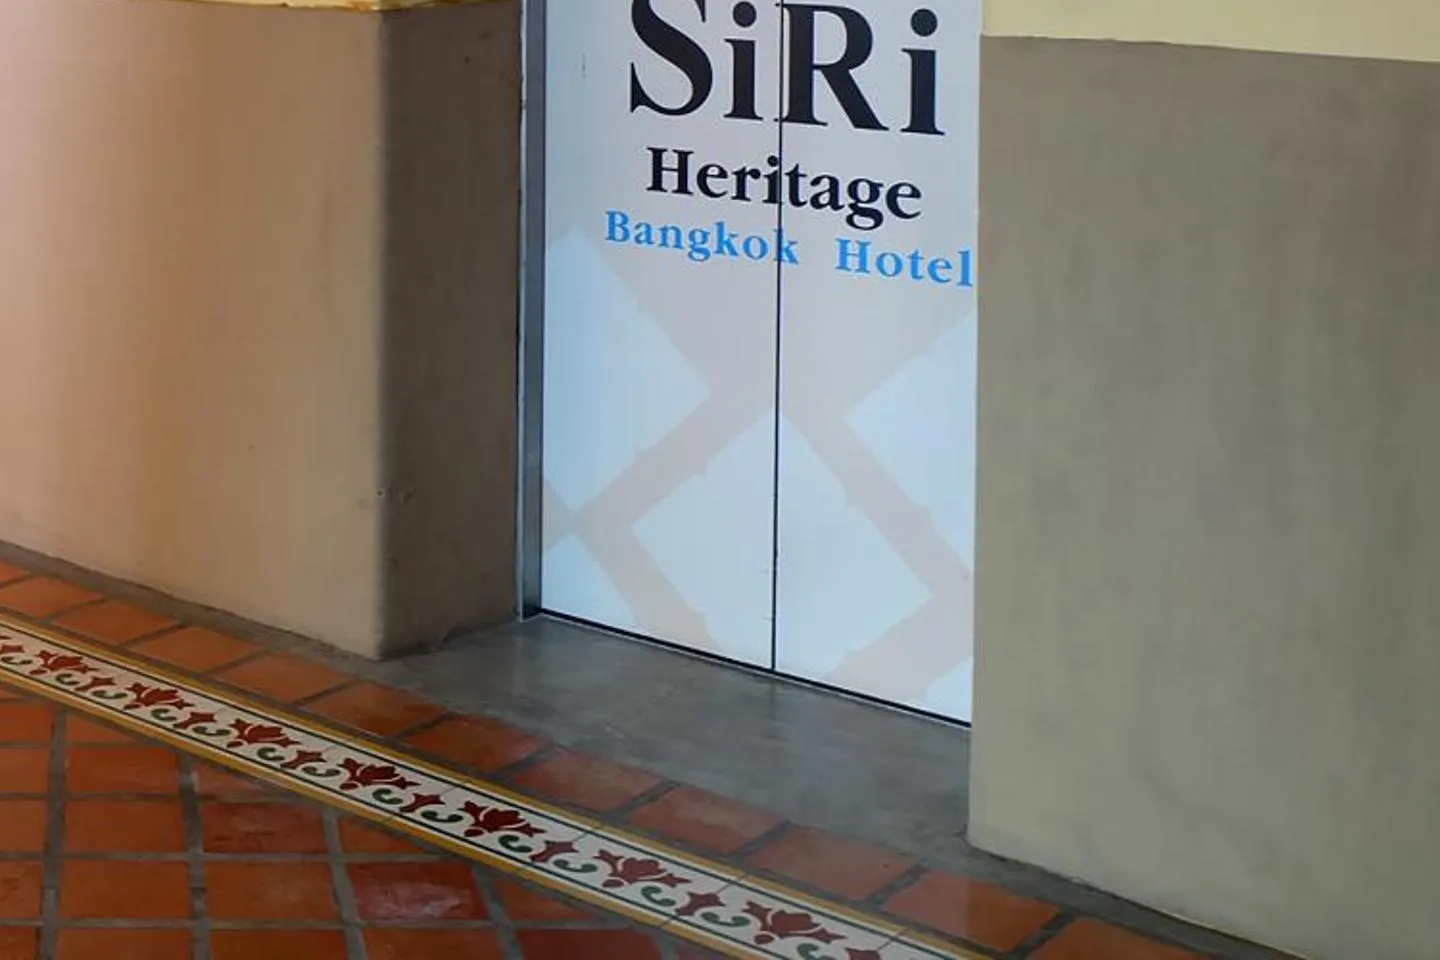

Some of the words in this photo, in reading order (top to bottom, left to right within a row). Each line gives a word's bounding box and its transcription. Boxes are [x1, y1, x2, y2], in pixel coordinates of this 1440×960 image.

[646, 147, 922, 230] Heritage
[604, 210, 800, 265] Bangkok
[835, 238, 974, 287] Hotel
